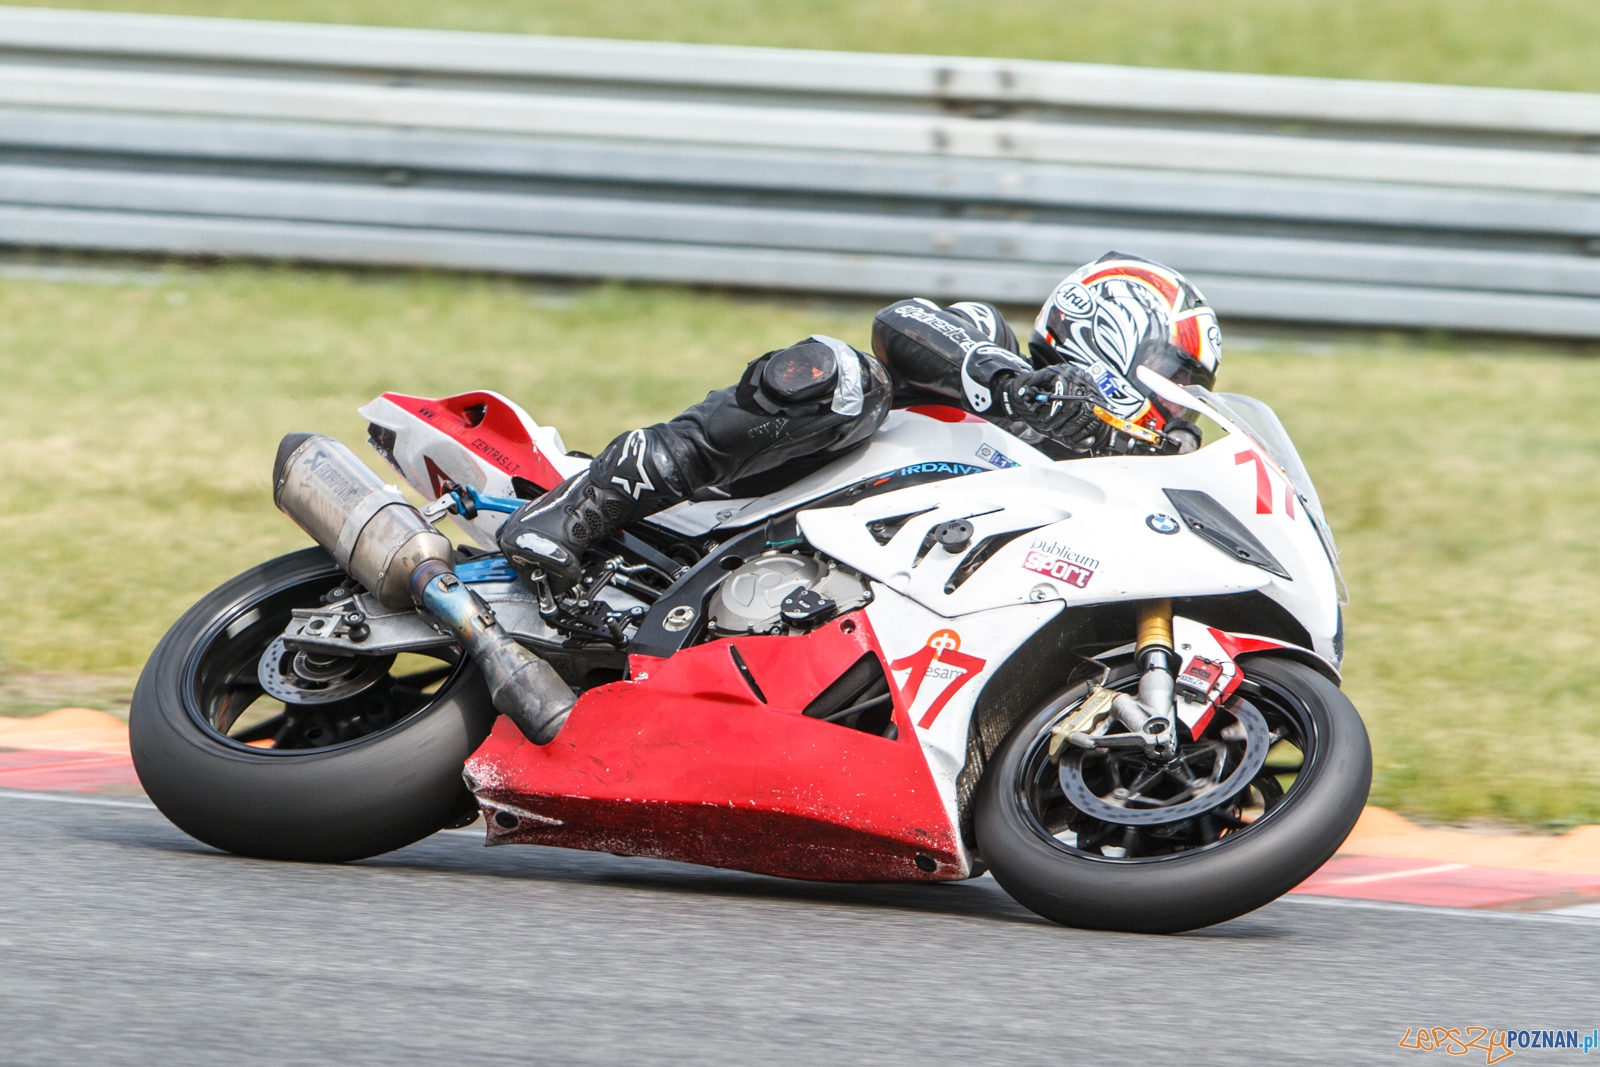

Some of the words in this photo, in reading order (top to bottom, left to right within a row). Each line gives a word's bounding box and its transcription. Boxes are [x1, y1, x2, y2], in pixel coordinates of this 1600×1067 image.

[1057, 286, 1091, 310] Arai
[1030, 537, 1100, 570] publicum
[888, 644, 987, 731] 17
